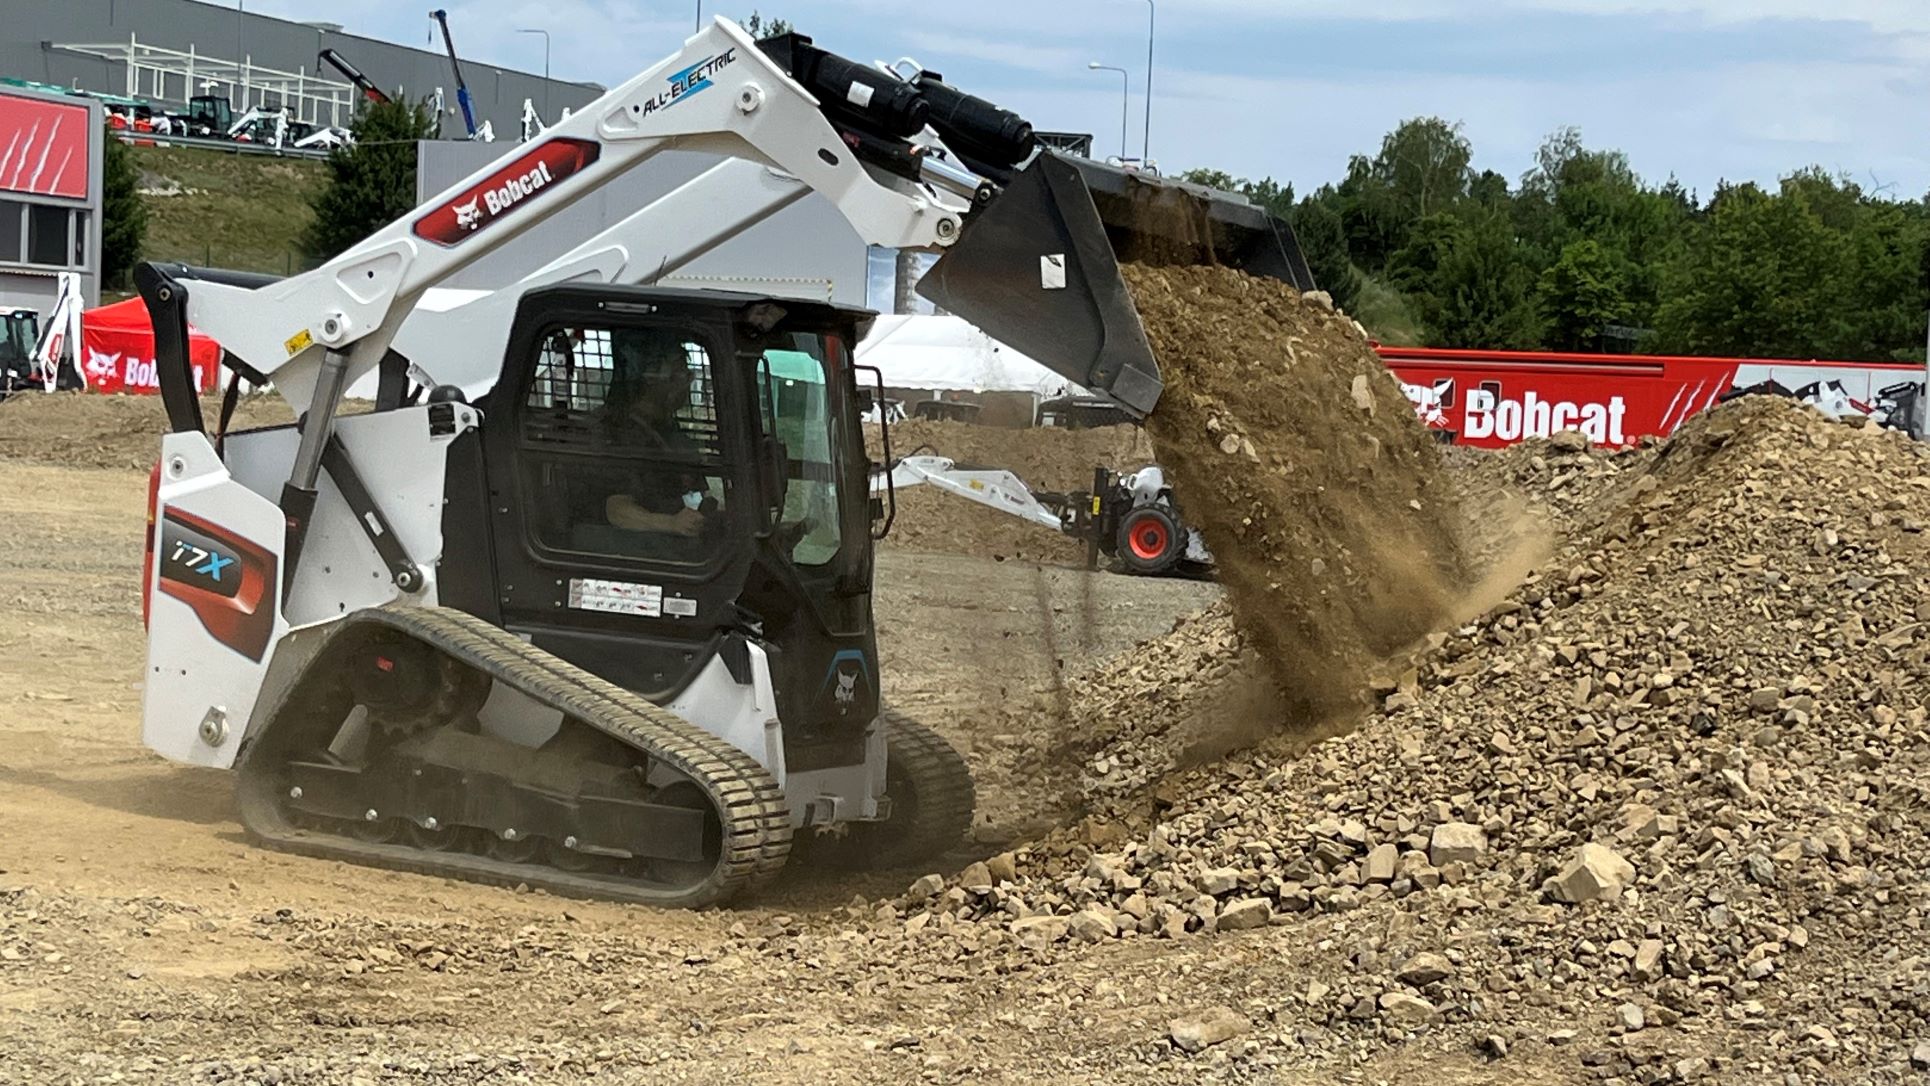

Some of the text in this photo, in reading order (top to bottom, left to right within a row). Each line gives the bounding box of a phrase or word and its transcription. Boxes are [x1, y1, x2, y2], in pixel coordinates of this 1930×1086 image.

[643, 47, 736, 117] ALL-ELECTRIC
[483, 160, 552, 216] Bobcat
[1464, 388, 1626, 445] Bobcat
